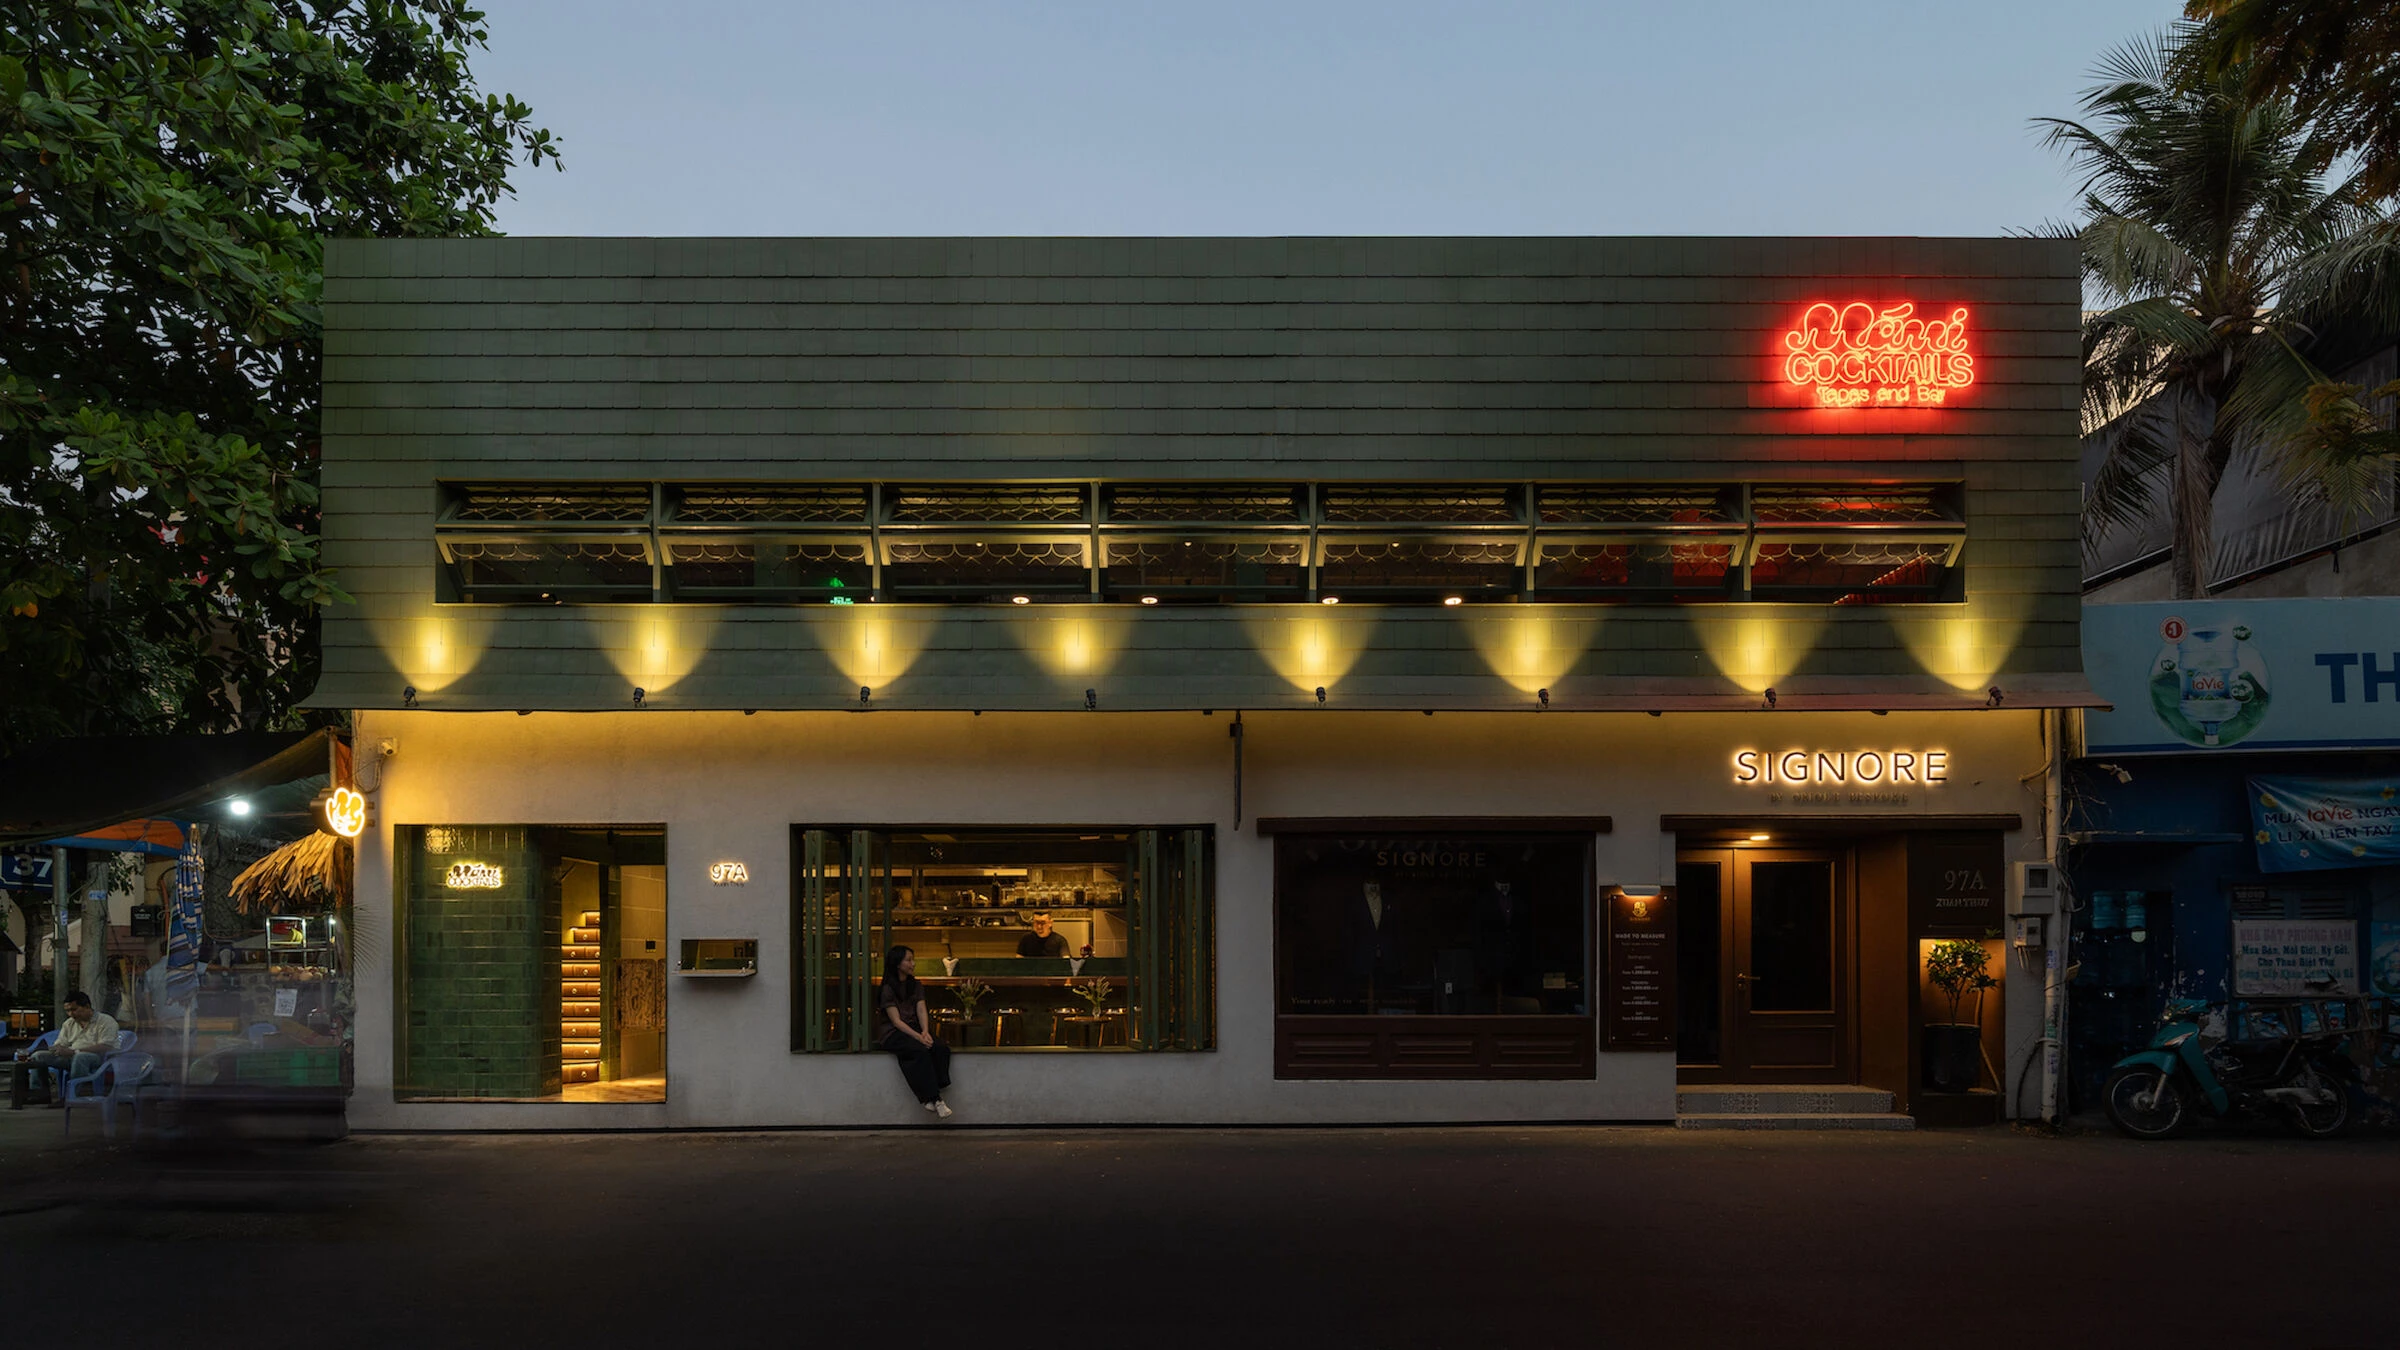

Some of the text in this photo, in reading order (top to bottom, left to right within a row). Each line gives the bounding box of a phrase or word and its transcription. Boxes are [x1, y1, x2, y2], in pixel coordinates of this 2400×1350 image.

[1785, 350, 1975, 388] COCKTAILS
[1876, 385, 1910, 403] and
[1737, 752, 1948, 782] SIGNORE
[2362, 825, 2393, 837] TAY
[13, 853, 54, 878] 37
[1376, 850, 1488, 868] SIGNORE
[712, 863, 746, 880] 97A
[1944, 869, 1988, 892] 97A
